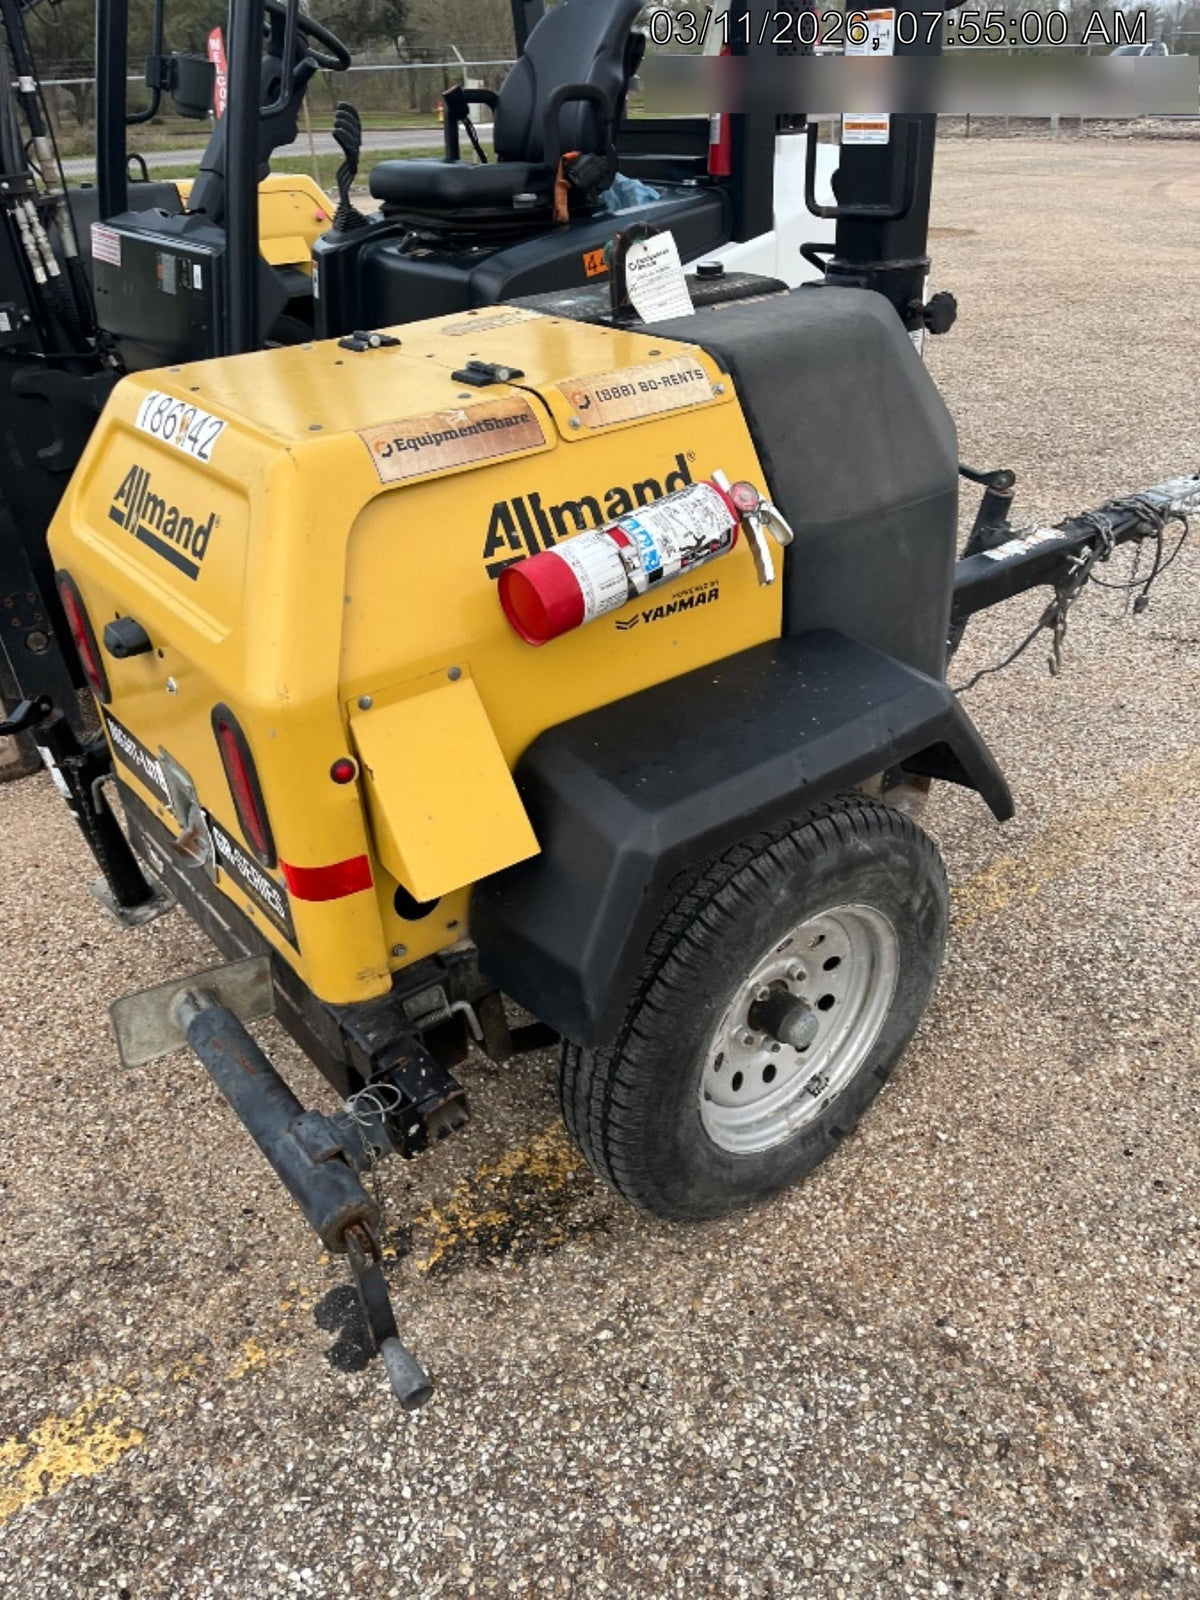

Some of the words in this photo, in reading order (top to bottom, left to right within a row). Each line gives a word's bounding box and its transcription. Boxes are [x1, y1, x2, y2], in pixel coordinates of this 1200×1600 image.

[394, 412, 530, 452] EquipmentShare
[113, 464, 216, 561] Allmand
[483, 452, 693, 559] Allmand
[641, 587, 719, 623] YANMAR
